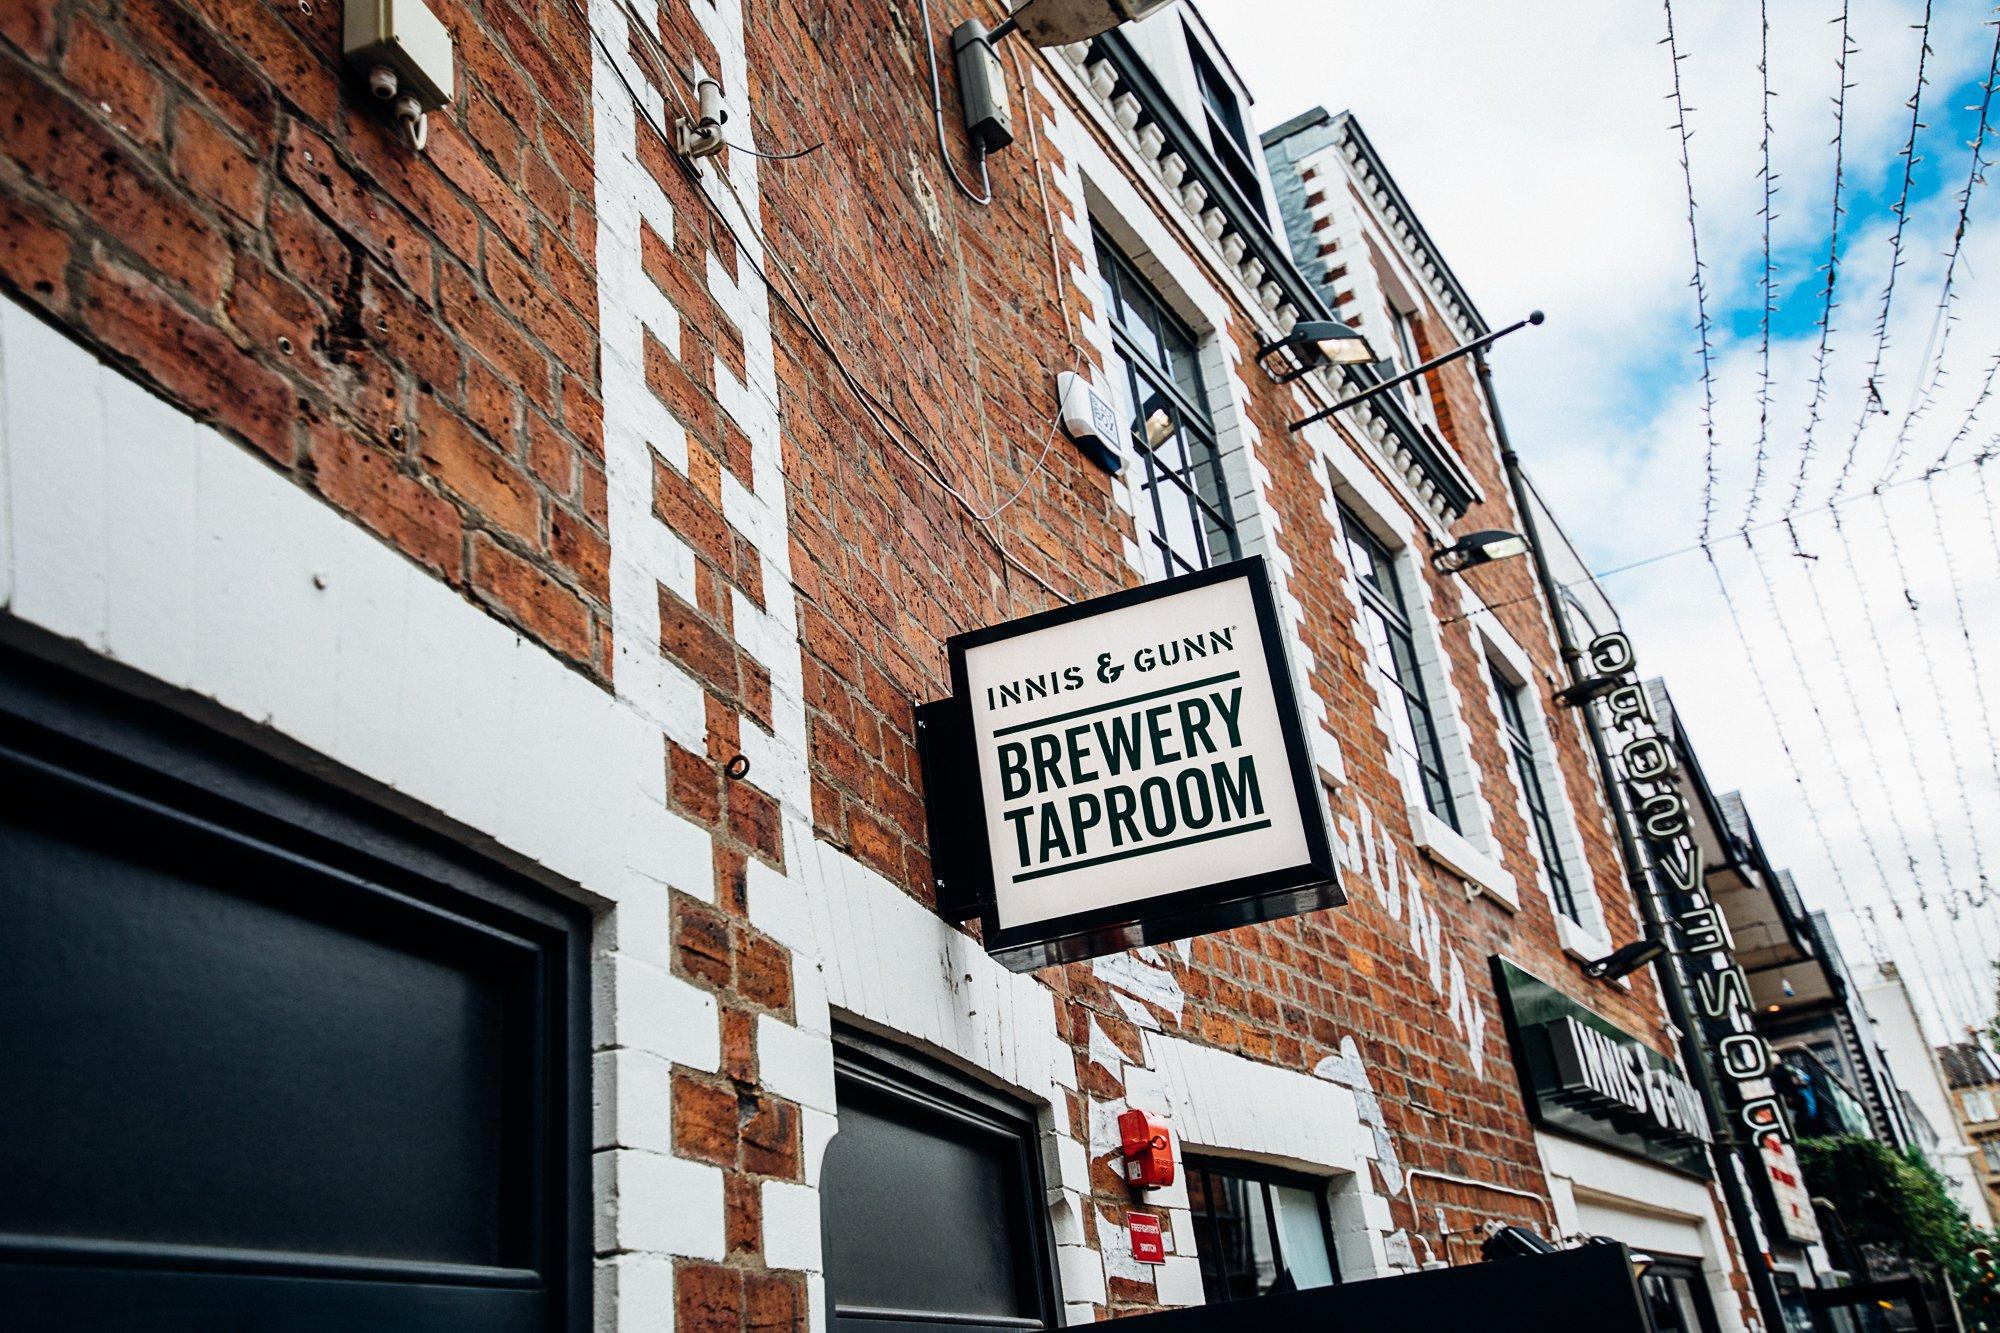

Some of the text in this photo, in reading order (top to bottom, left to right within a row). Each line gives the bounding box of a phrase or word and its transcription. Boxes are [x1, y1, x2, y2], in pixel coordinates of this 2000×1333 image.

[987, 666, 1084, 711] INNIS
[1096, 652, 1125, 684] &
[997, 687, 1243, 801] BREWERY
[1004, 755, 1264, 867] TAPROOM
[1566, 1014, 1647, 1114] INNIS
